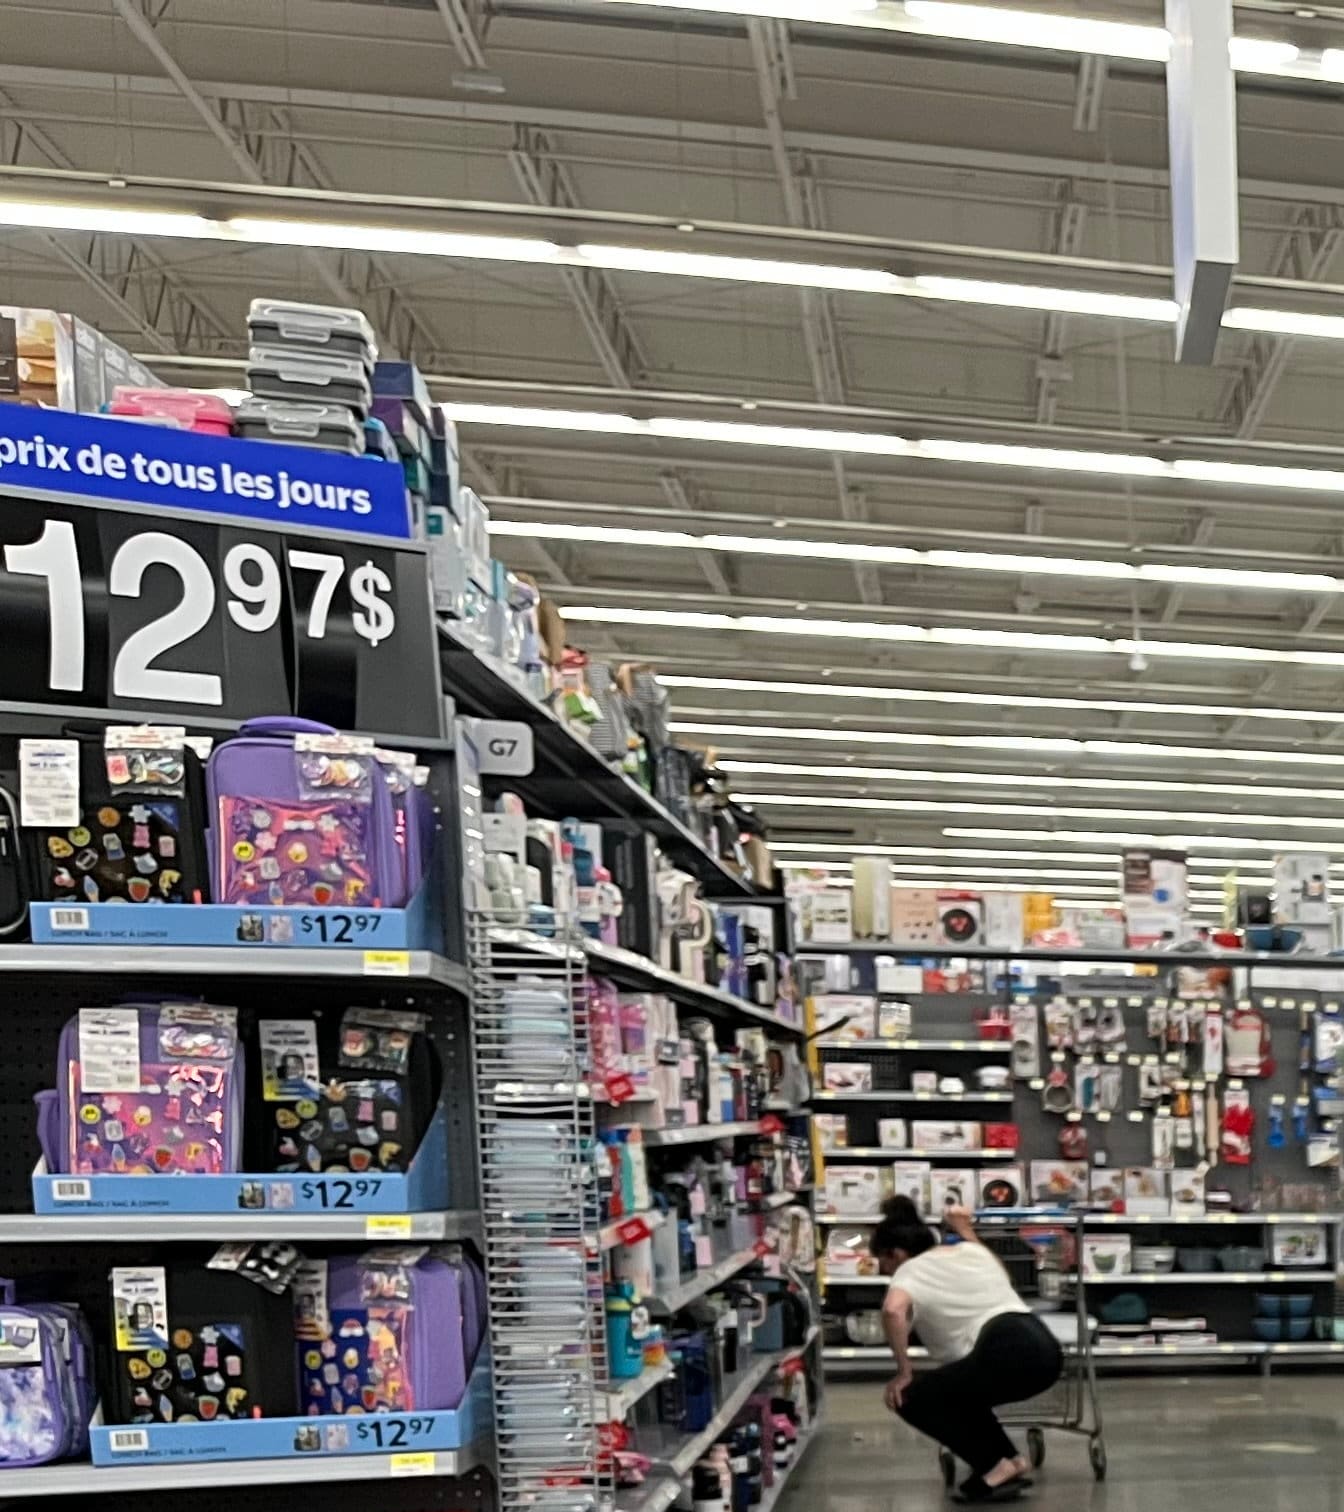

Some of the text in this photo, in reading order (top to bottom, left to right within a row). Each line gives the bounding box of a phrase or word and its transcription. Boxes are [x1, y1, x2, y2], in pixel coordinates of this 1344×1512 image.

[0, 435, 372, 515] prix de tous les jours
[489, 738, 518, 757] G7
